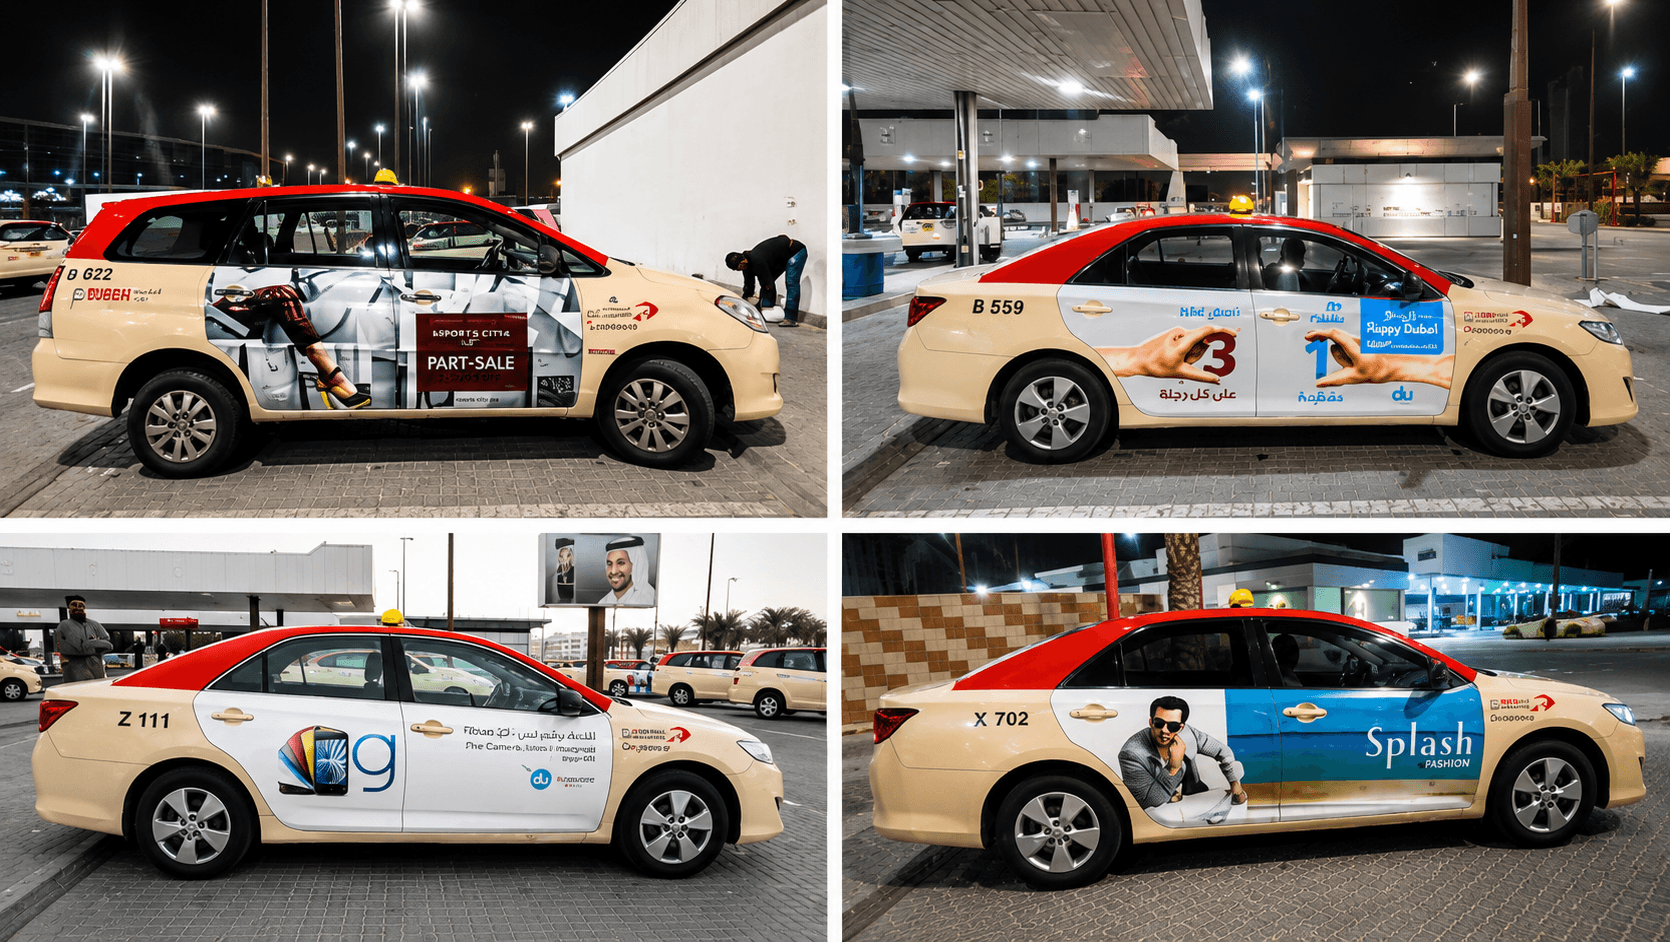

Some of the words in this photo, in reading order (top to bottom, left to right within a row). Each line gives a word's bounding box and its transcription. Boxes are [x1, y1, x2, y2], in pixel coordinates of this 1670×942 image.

[67, 269, 78, 280] B
[972, 299, 984, 314] B
[990, 299, 1024, 315] 559
[428, 355, 515, 370] PART-SALE
[1203, 331, 1236, 378] 3
[1305, 339, 1328, 380] 1
[1391, 385, 1414, 401] du
[118, 711, 132, 727] Z
[138, 712, 170, 728] 111
[974, 712, 987, 727] X
[994, 711, 1029, 726] 702
[1366, 721, 1472, 769] Splash
[352, 733, 396, 793] g
[533, 772, 549, 785] du
